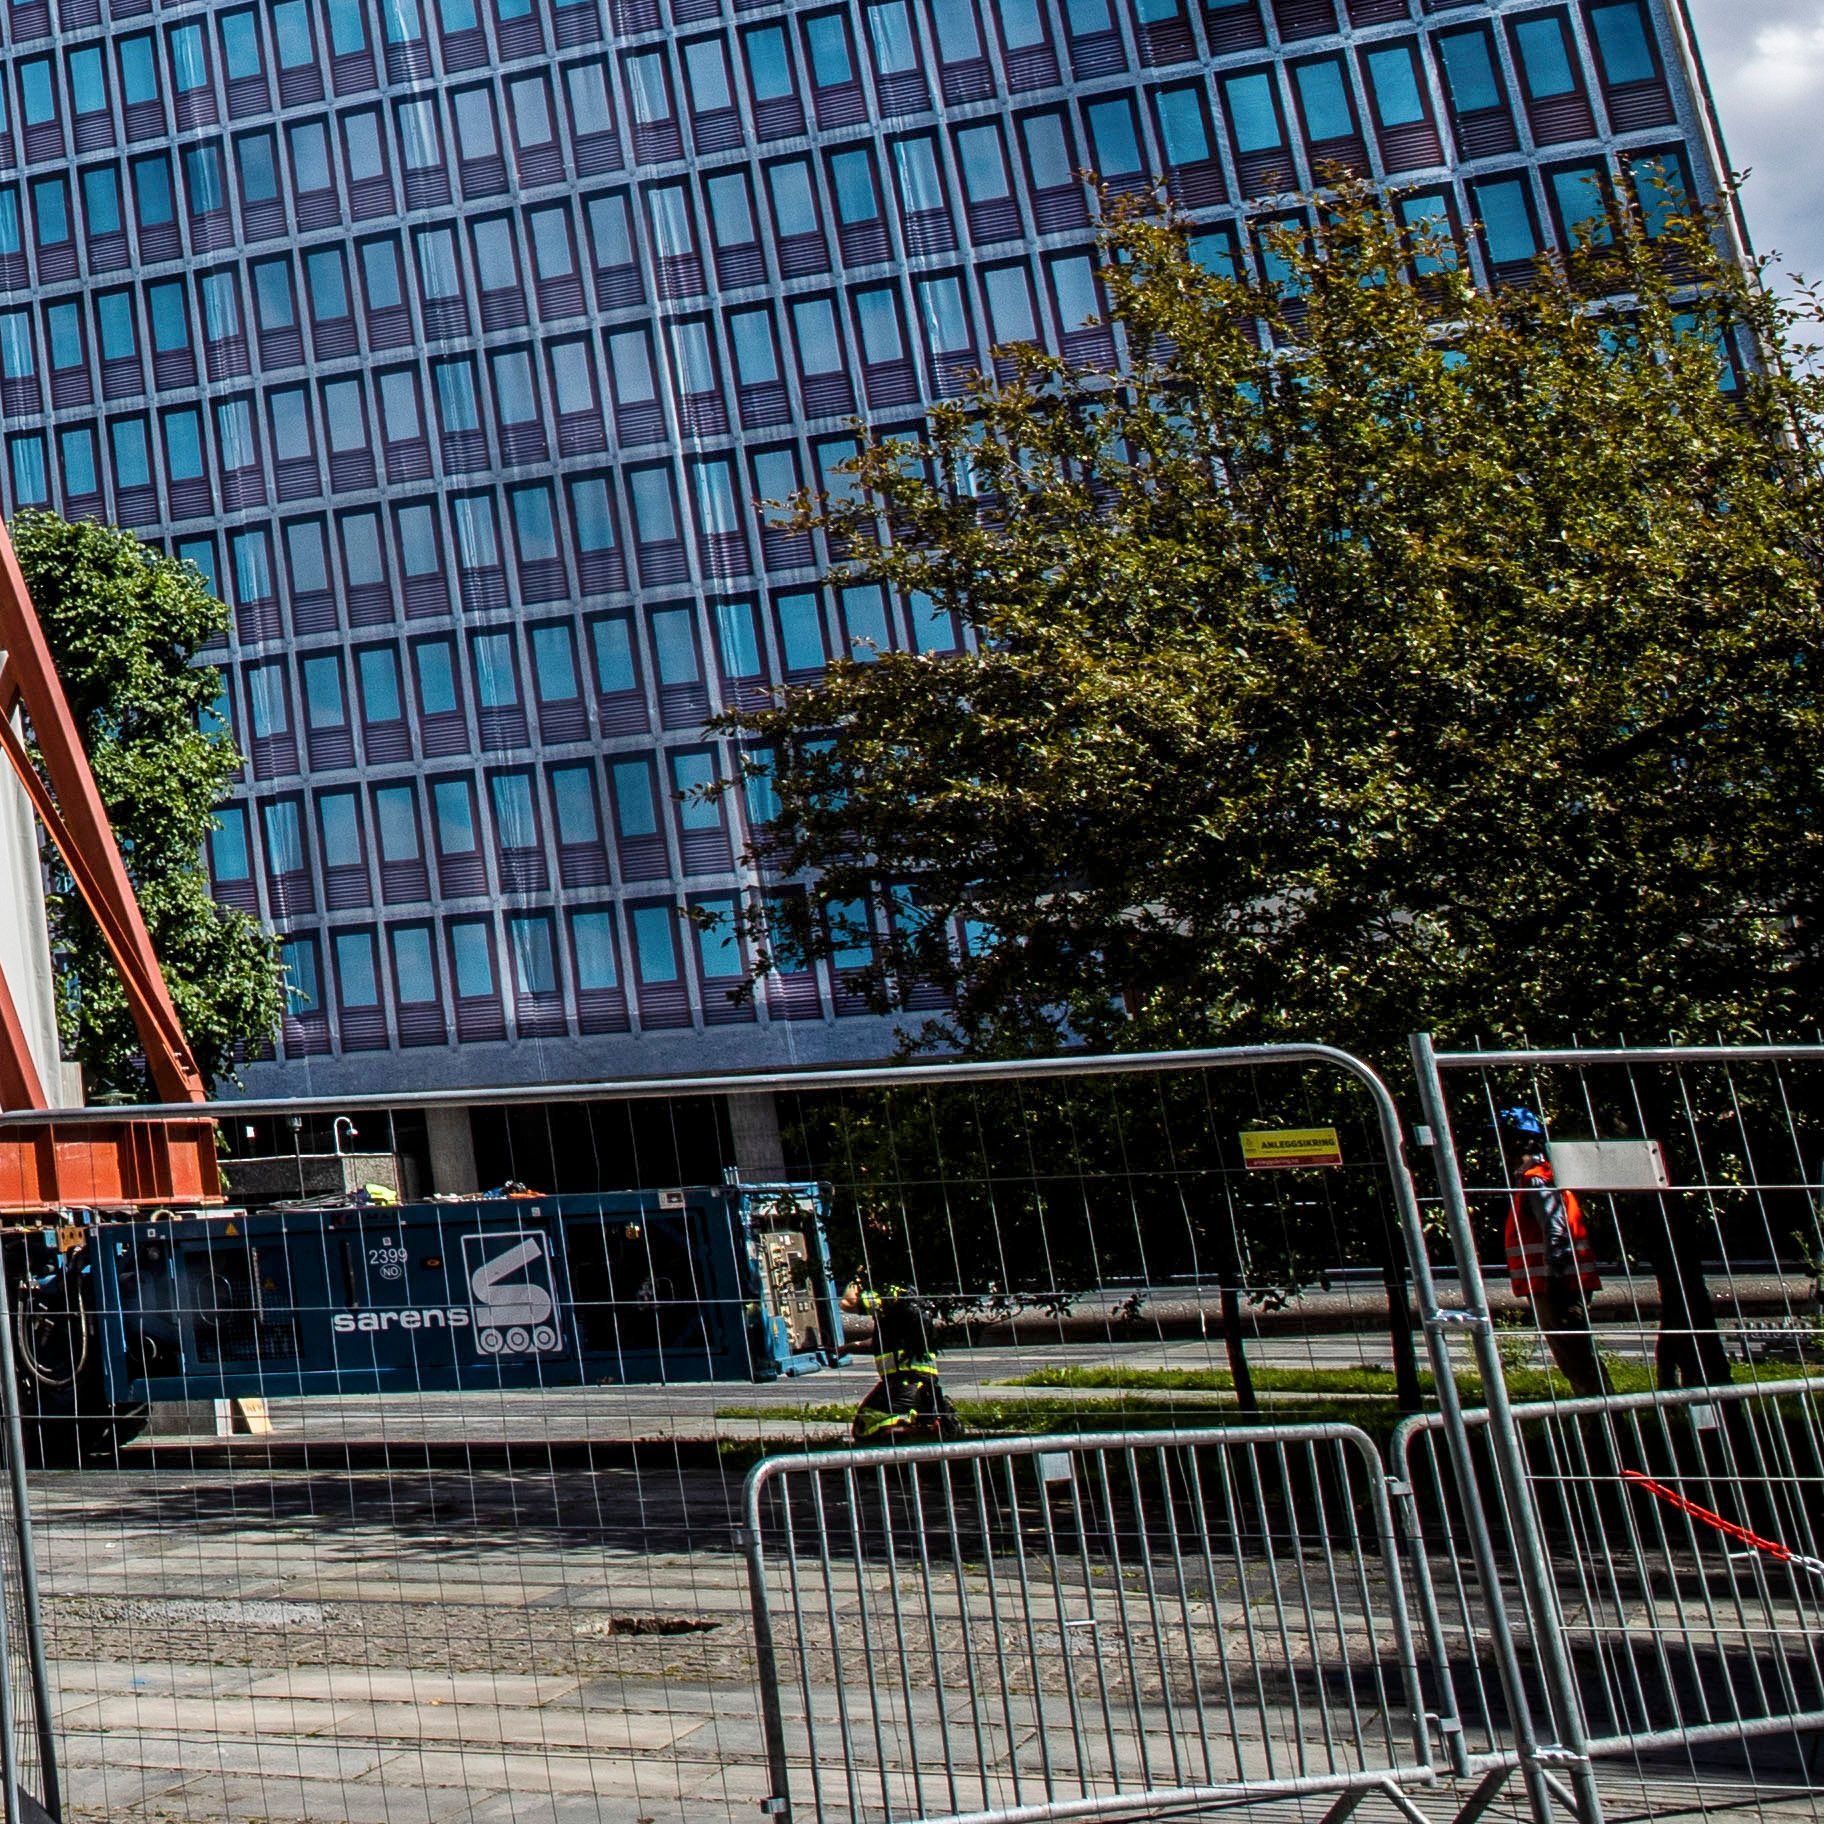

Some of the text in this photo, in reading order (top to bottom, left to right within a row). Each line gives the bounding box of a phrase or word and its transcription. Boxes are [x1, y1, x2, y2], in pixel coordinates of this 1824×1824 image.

[368, 1247, 408, 1265] 2399
[382, 1266, 400, 1277] NO
[333, 1307, 469, 1332] sarens
